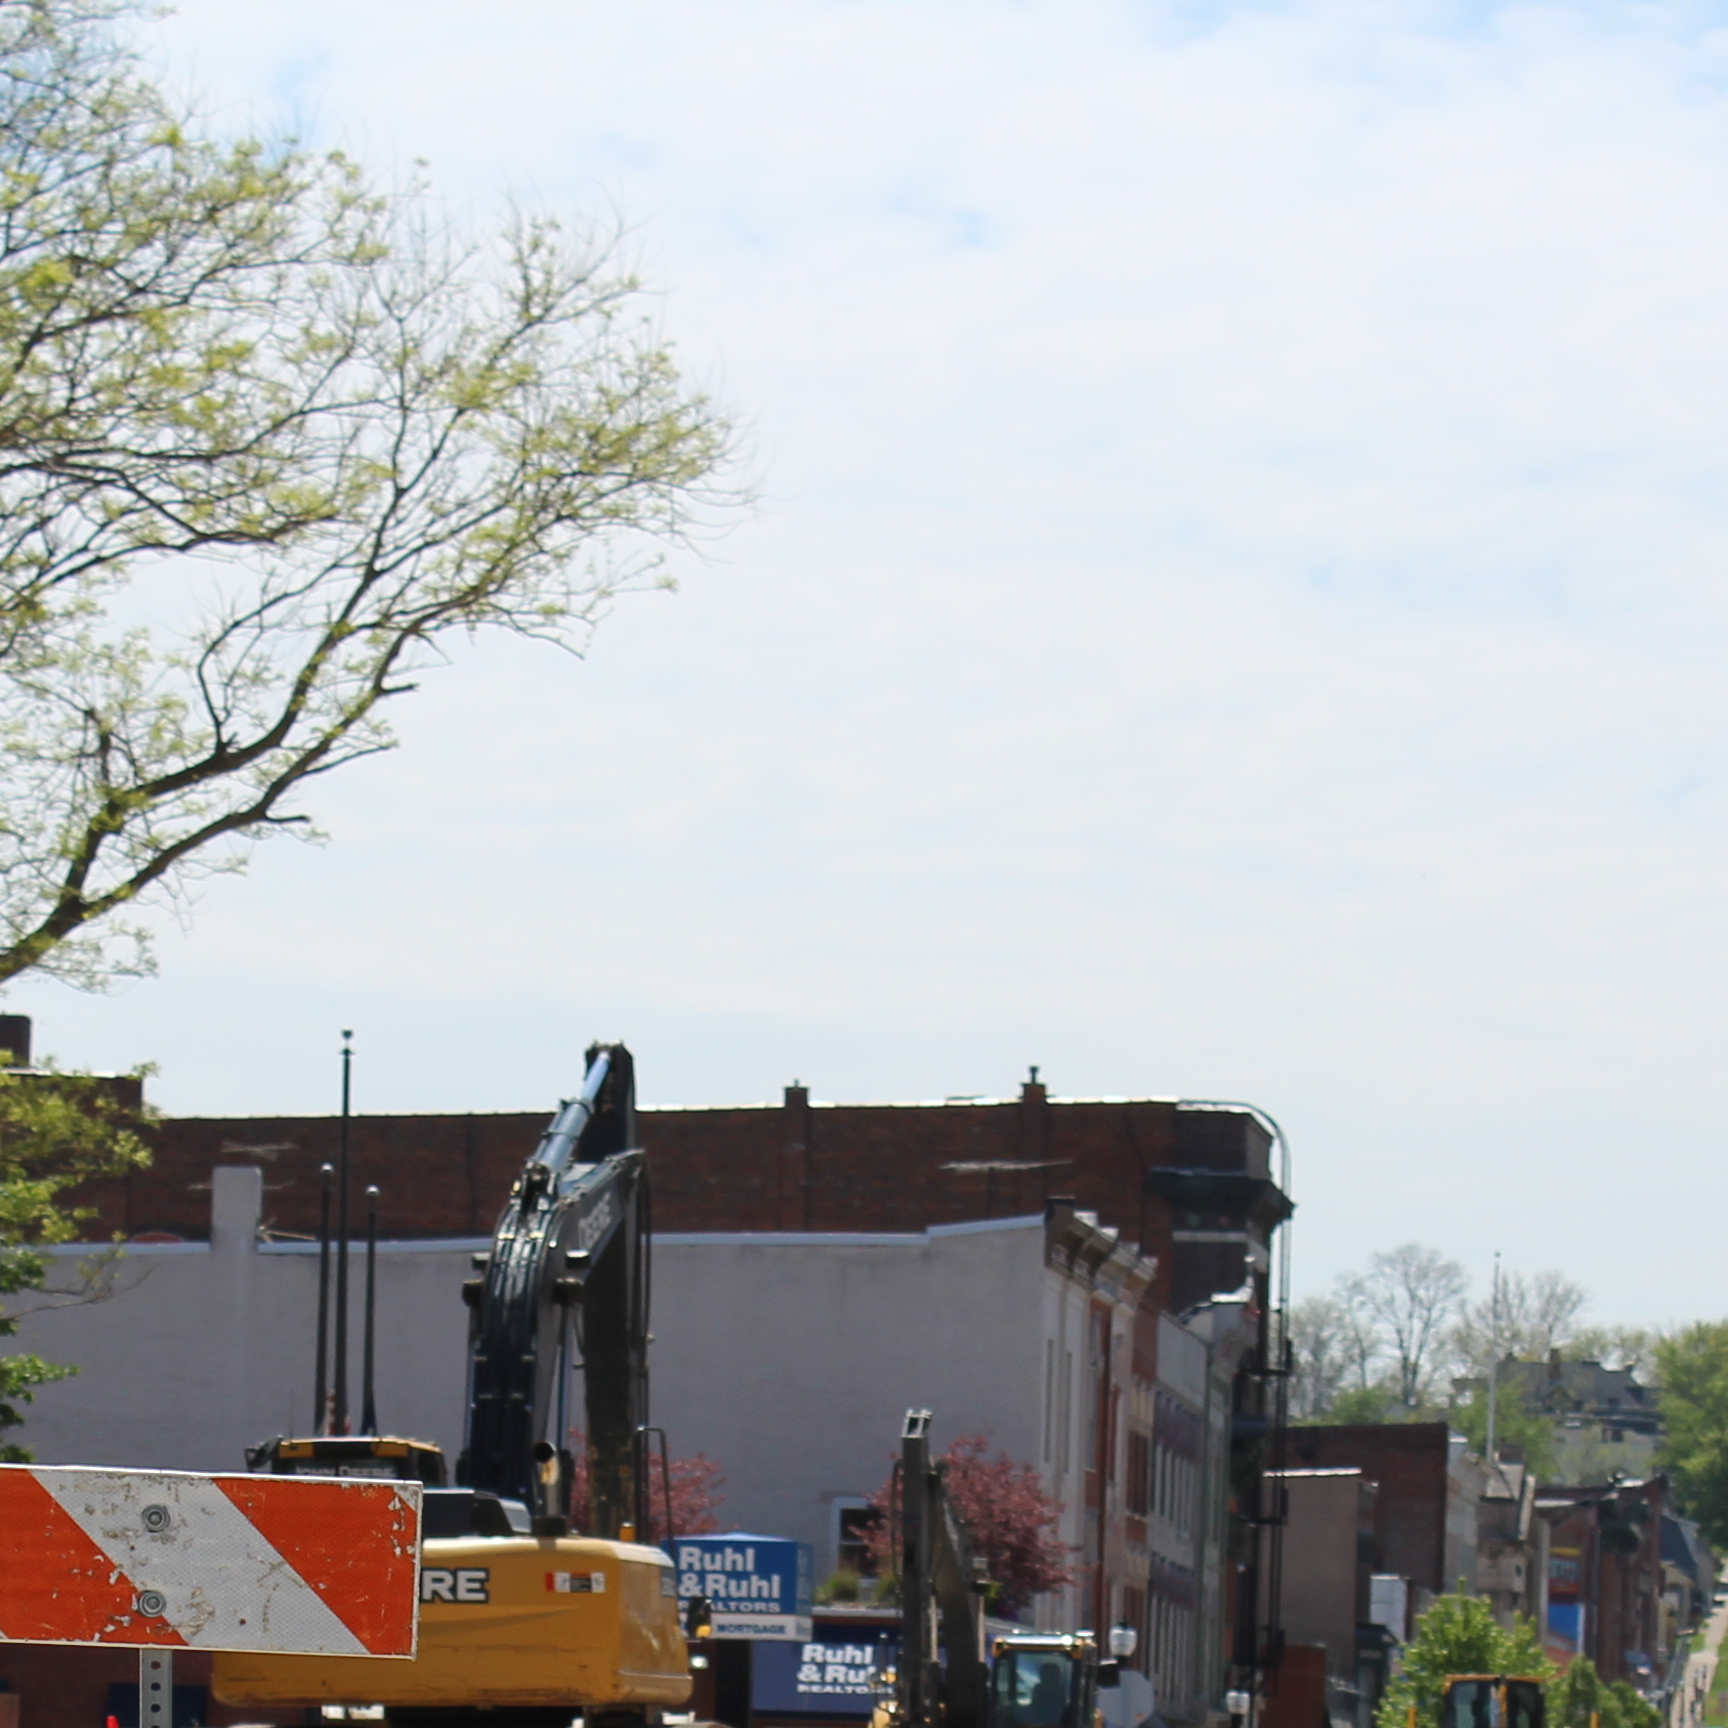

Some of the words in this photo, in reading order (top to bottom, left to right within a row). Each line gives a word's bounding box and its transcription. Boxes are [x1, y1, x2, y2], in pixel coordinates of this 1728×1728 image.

[679, 1546, 755, 1571] Ruhl
[678, 1573, 780, 1598] &Ruhl
[678, 1601, 780, 1613] RALTORS
[802, 1643, 874, 1664] Ruhl
